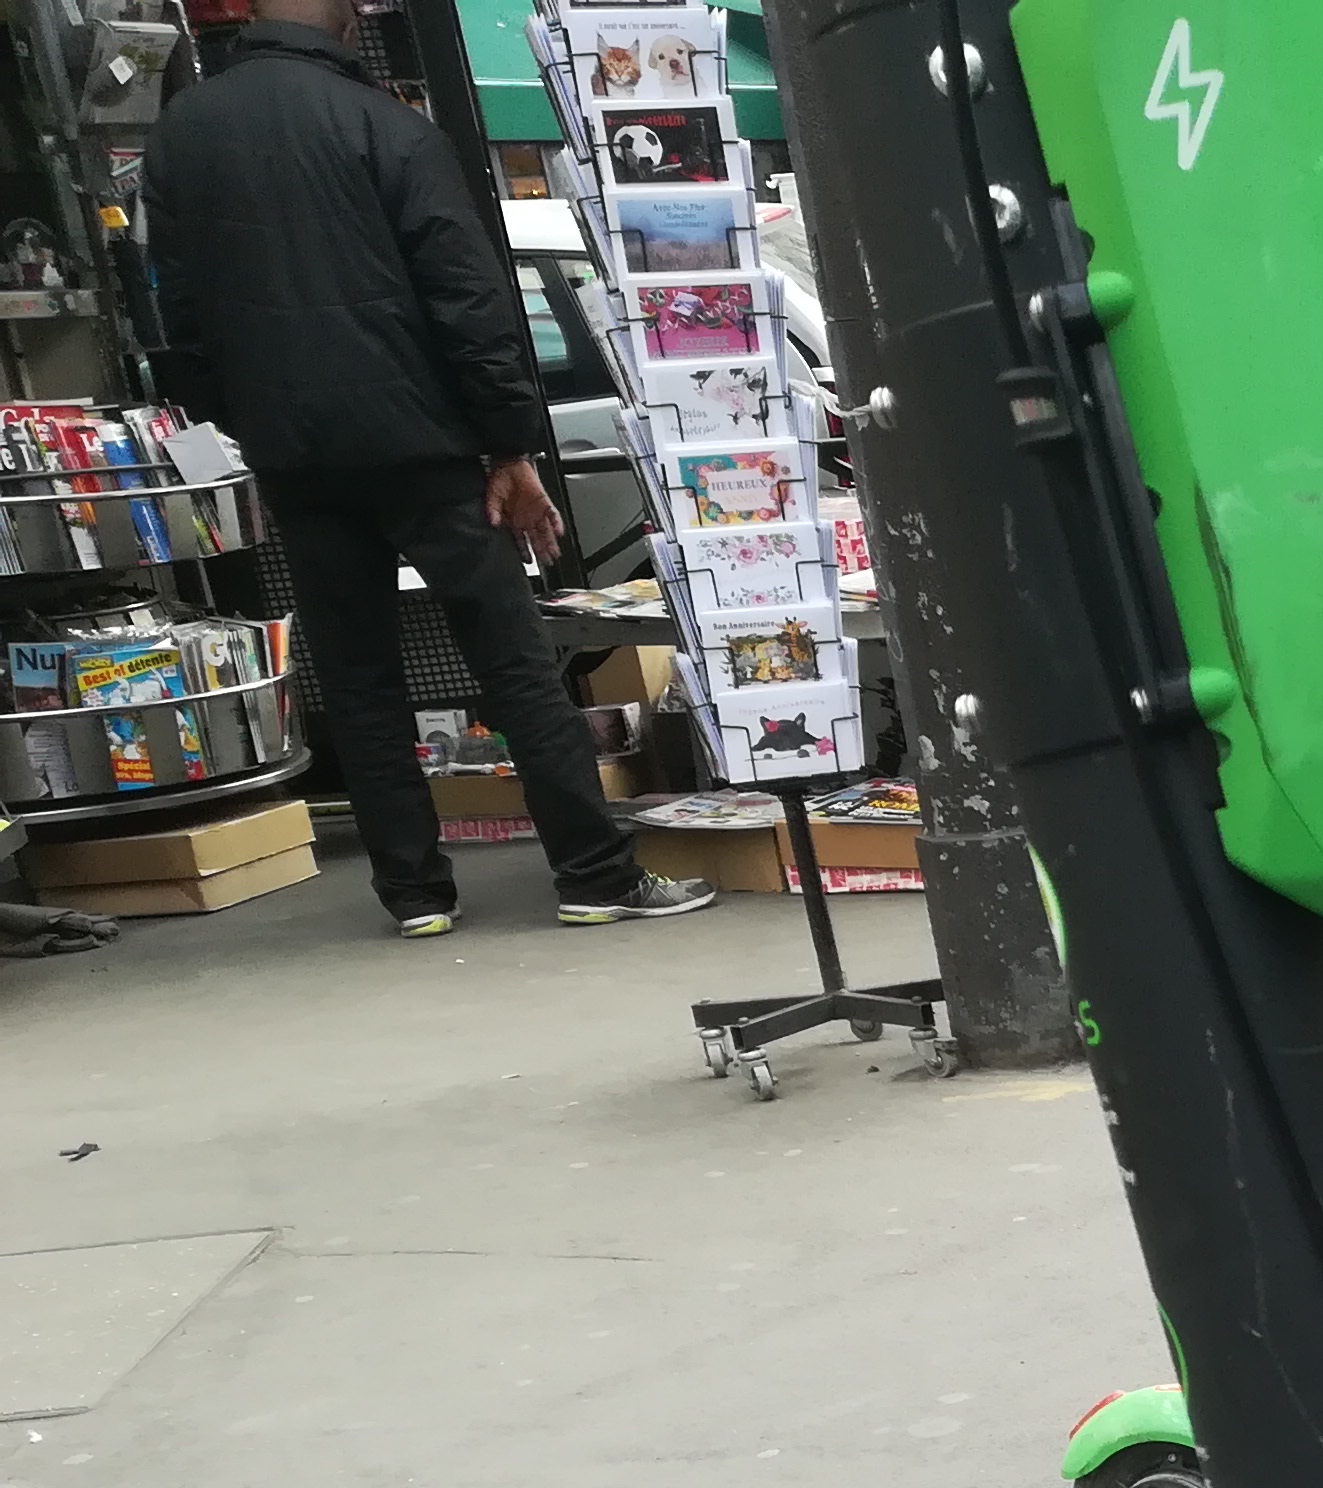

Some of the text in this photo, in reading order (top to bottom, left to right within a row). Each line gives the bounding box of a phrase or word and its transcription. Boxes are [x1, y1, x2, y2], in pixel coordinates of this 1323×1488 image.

[711, 478, 769, 492] HEUREUX
[713, 620, 776, 631] Bon Anniversaire
[83, 672, 112, 688] Best
